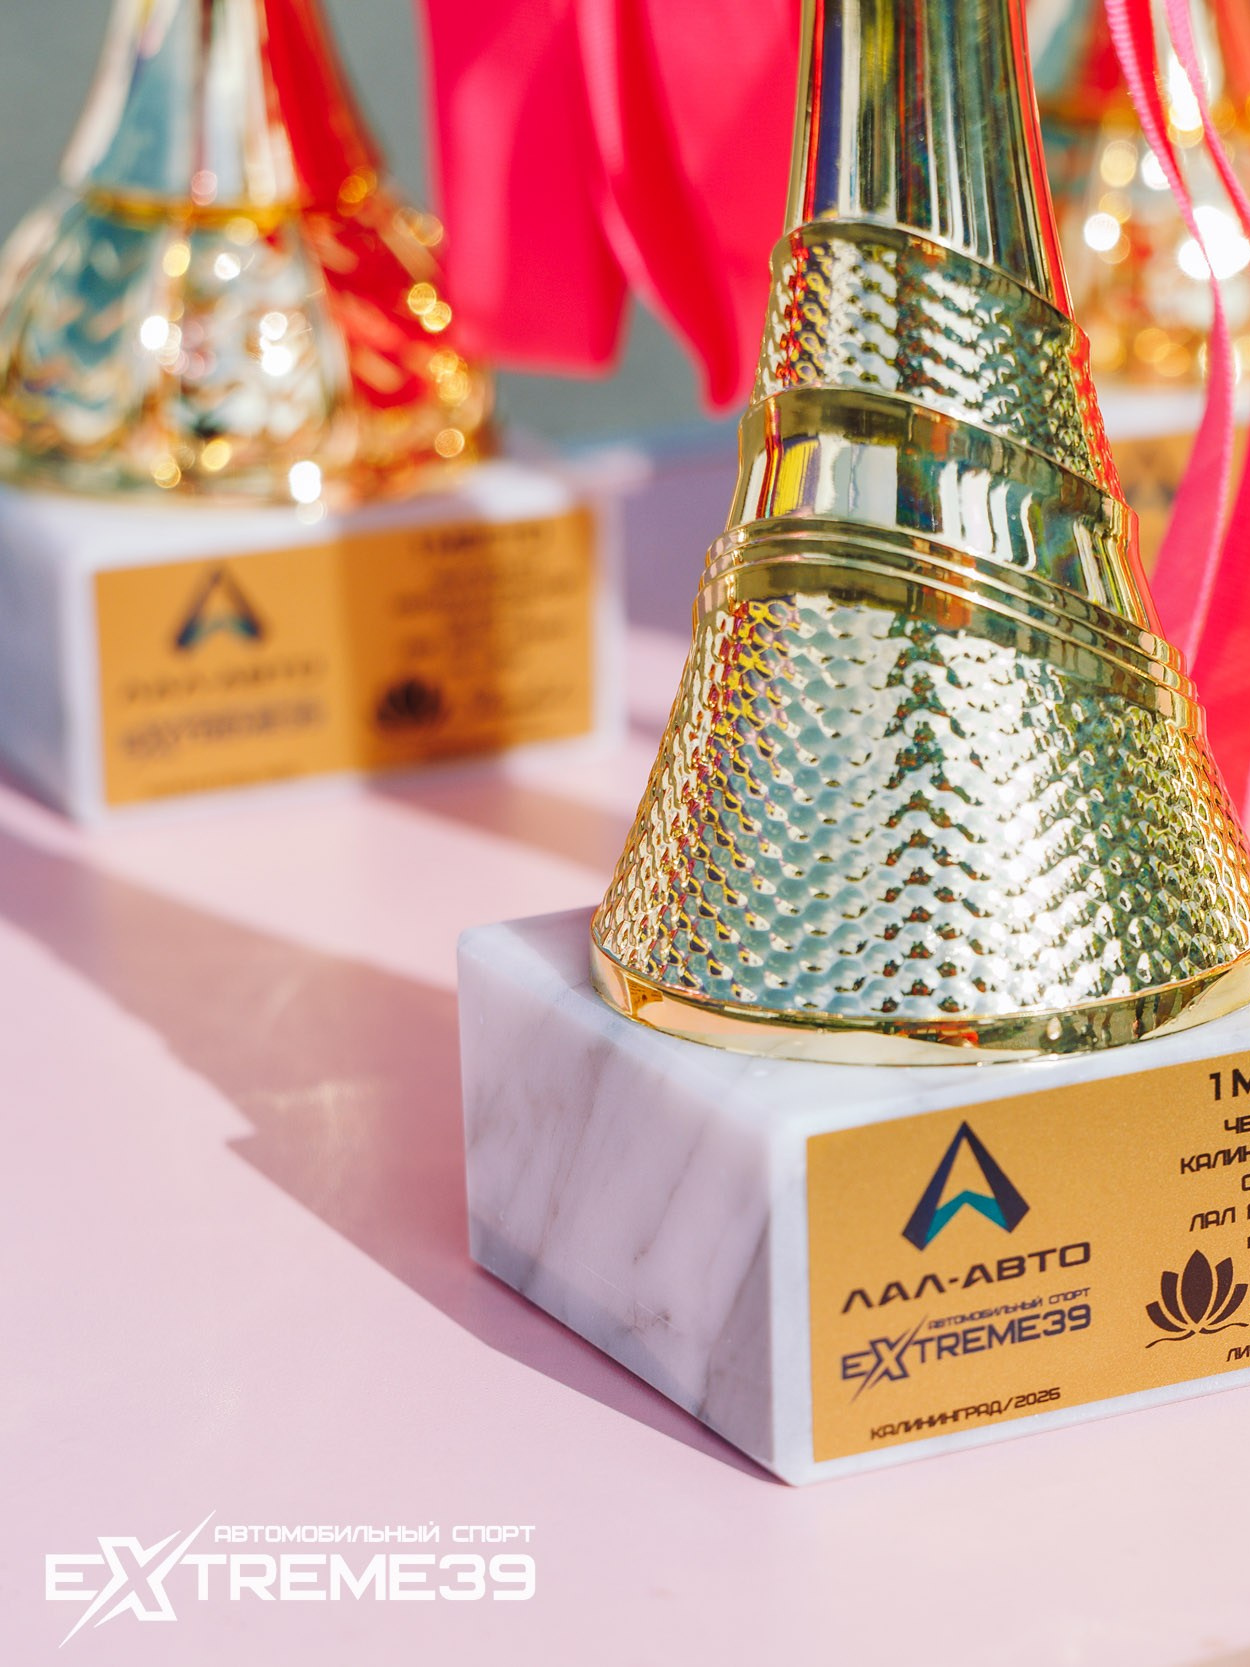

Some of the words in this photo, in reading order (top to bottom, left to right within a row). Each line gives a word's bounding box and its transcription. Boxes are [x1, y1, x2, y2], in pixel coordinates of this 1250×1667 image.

[1209, 1071, 1221, 1101] 1
[1189, 1206, 1236, 1232] ЛАЛ
[841, 1241, 1091, 1314] ЛАЛ-АВТО
[928, 1295, 1043, 1330] АВТОМОБИЛЬНЫЙ
[1049, 1287, 1091, 1305] СПОРТ
[841, 1303, 1091, 1405] EXTREME39
